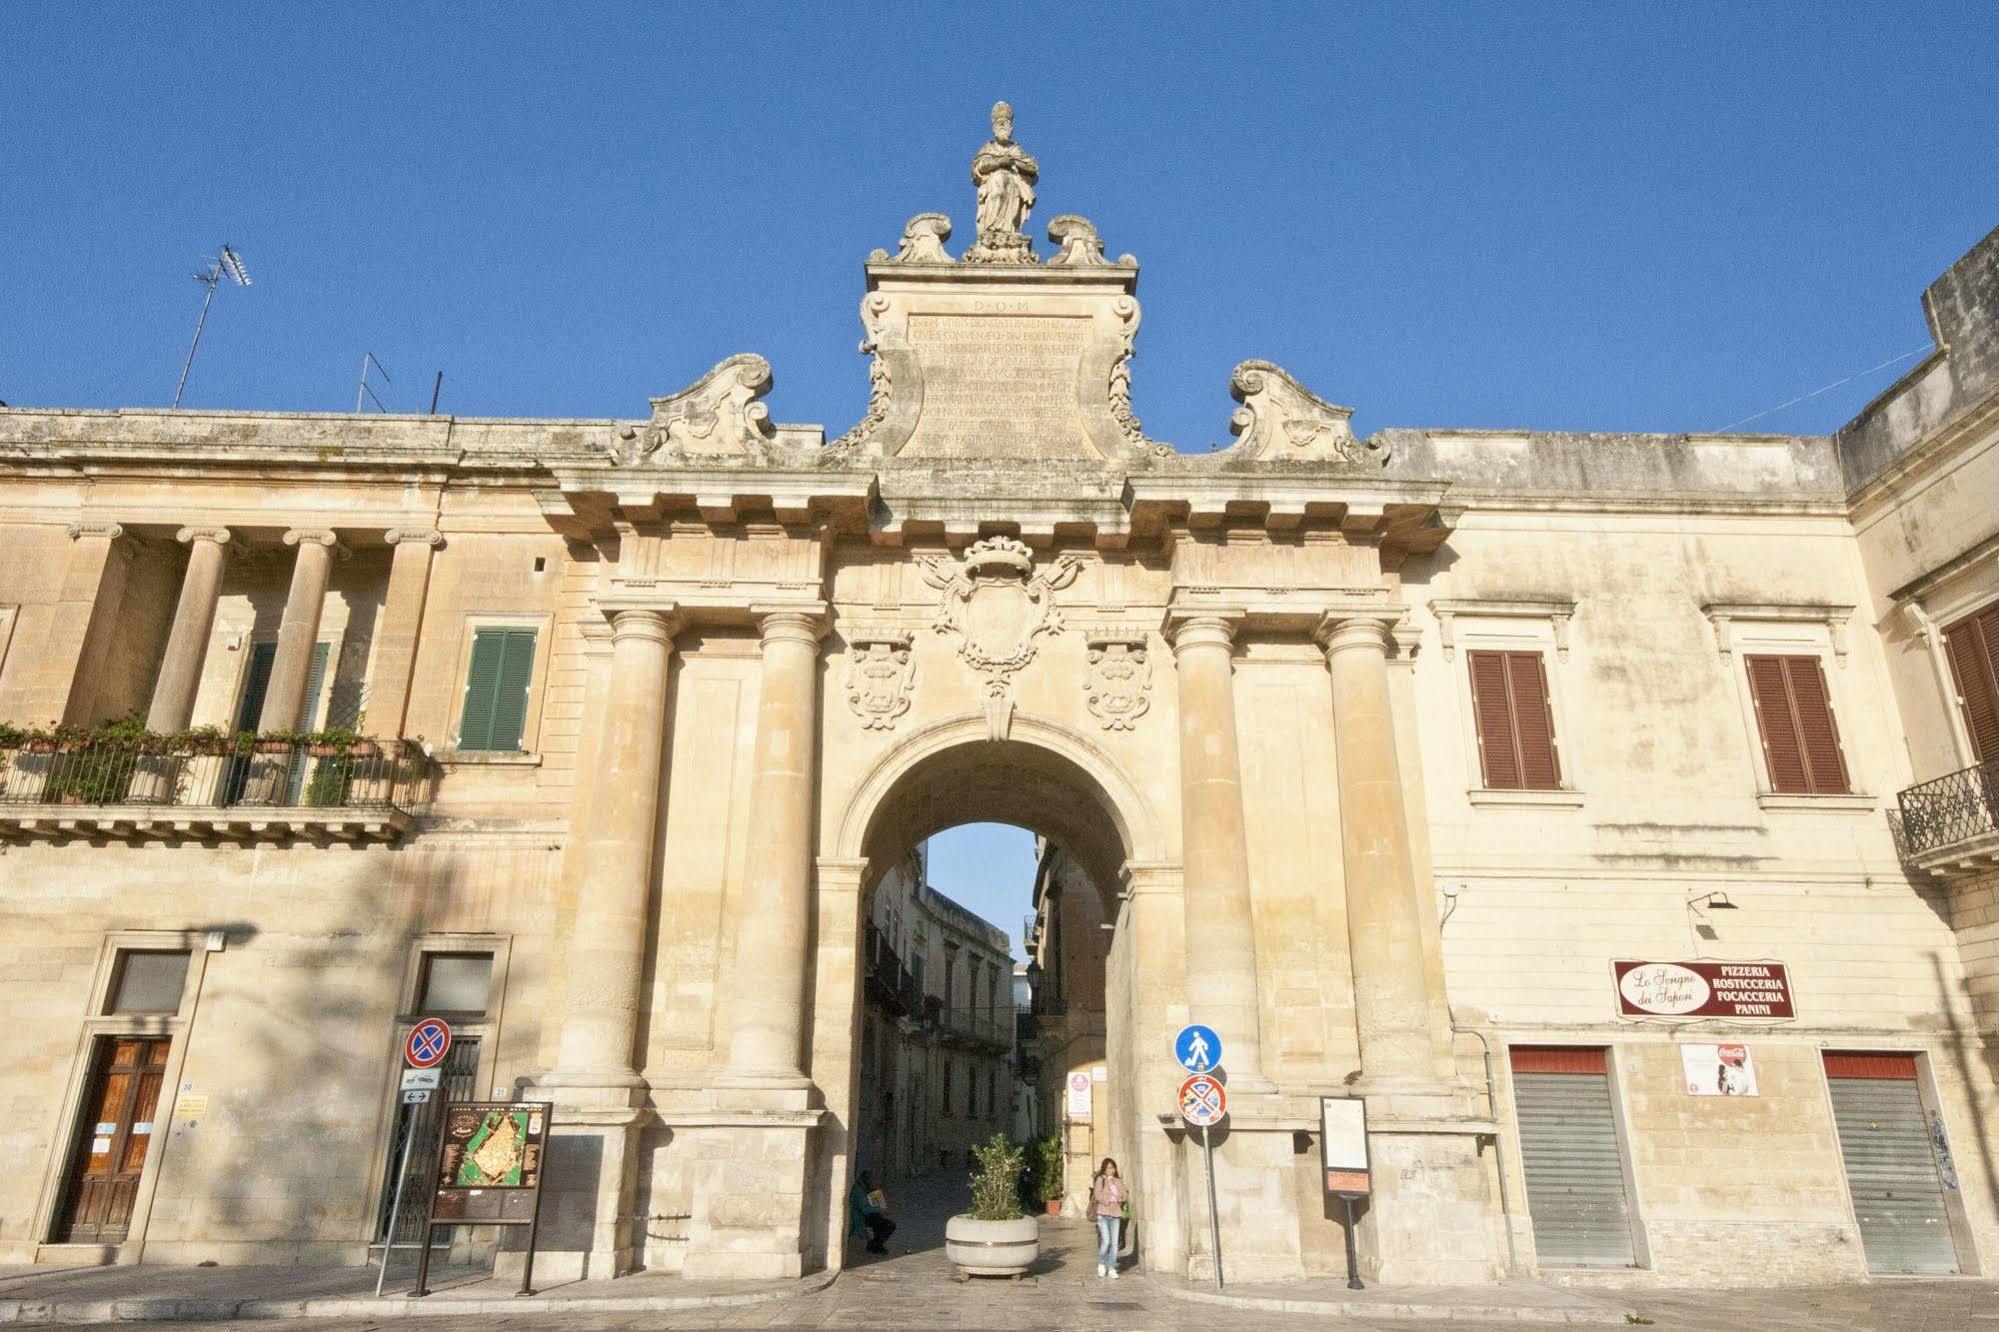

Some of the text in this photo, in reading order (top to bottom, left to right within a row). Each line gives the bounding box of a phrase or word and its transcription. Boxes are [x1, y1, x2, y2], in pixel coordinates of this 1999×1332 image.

[1721, 966, 1770, 977] PIZZERIA
[1712, 978, 1784, 990] ROSTICCERIA
[1637, 985, 1692, 1007] dei Sapori
[1717, 991, 1784, 1002] FOCACCERIA
[1734, 1004, 1771, 1015] PANINI
